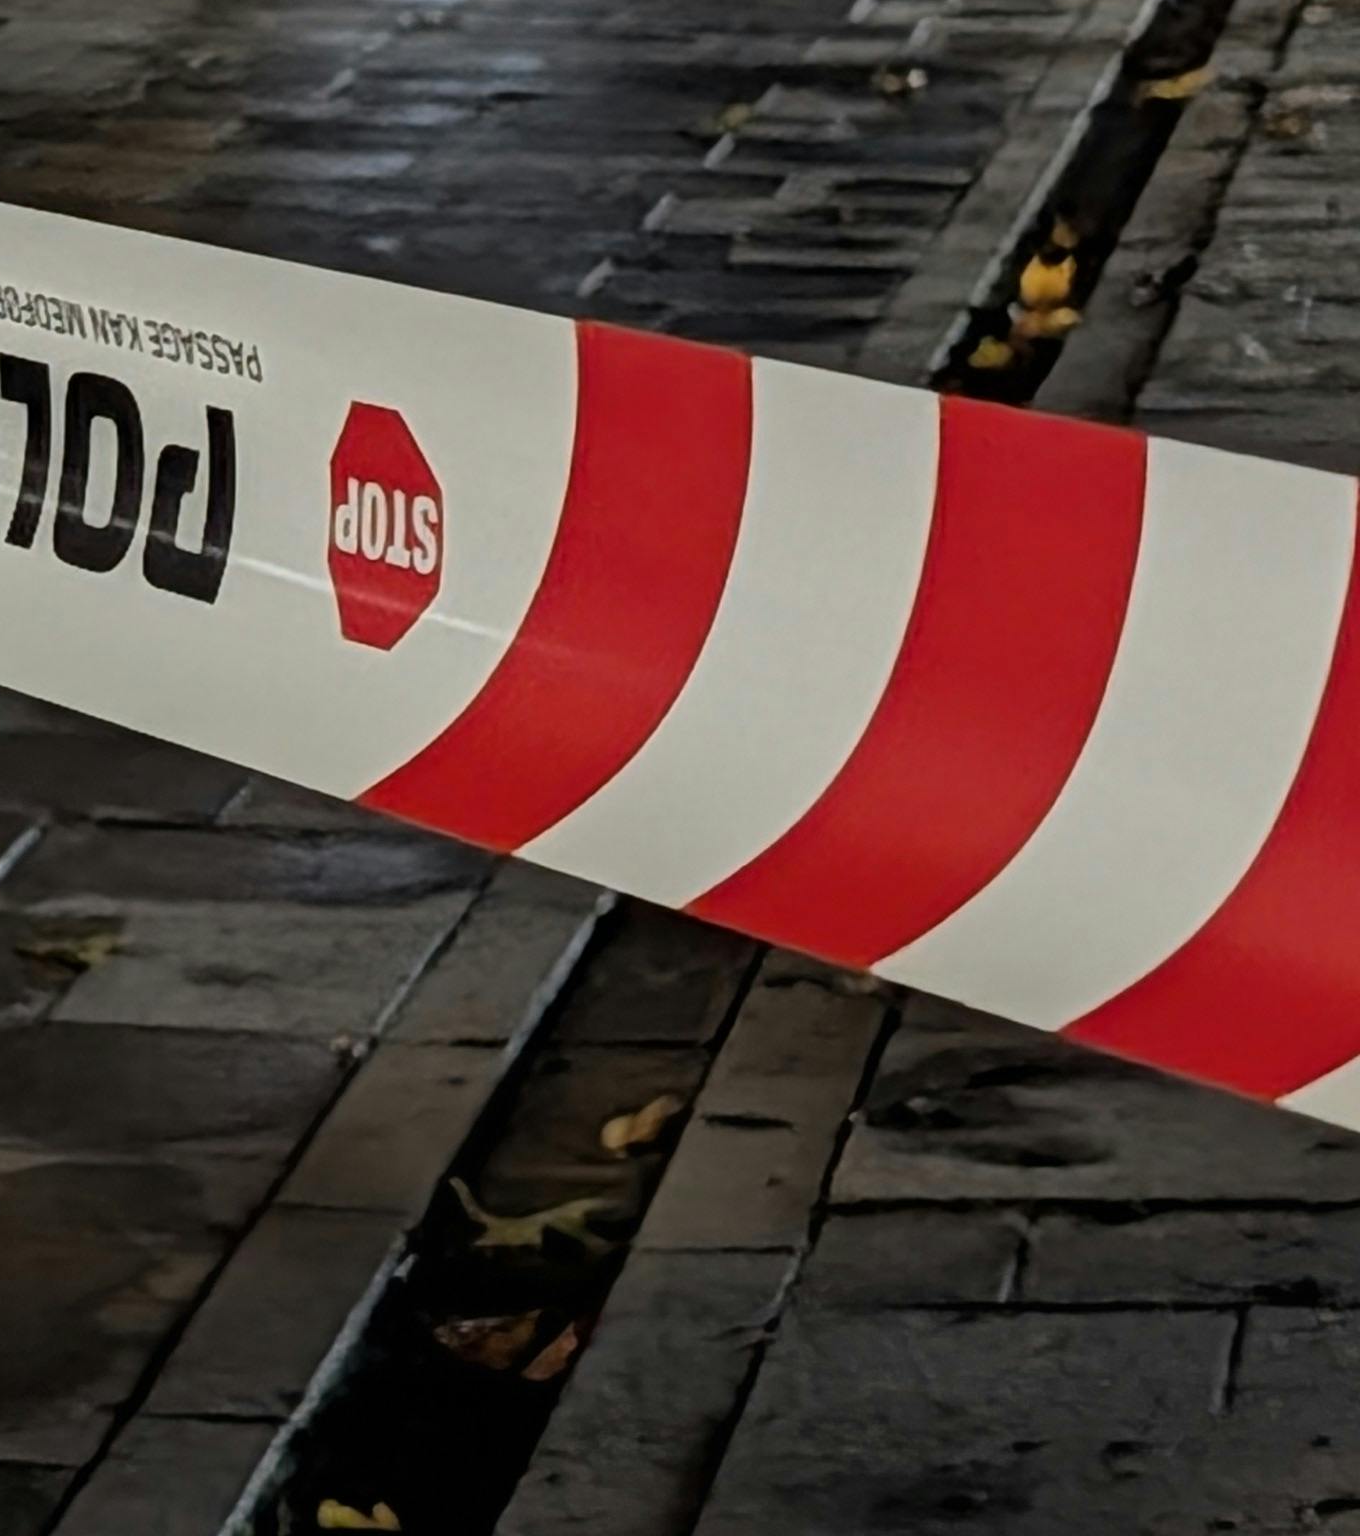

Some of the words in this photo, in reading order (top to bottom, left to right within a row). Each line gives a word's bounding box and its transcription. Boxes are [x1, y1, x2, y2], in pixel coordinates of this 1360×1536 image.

[87, 307, 143, 353] KAN
[143, 320, 263, 383] PASSAGE
[335, 476, 439, 575] STOP
